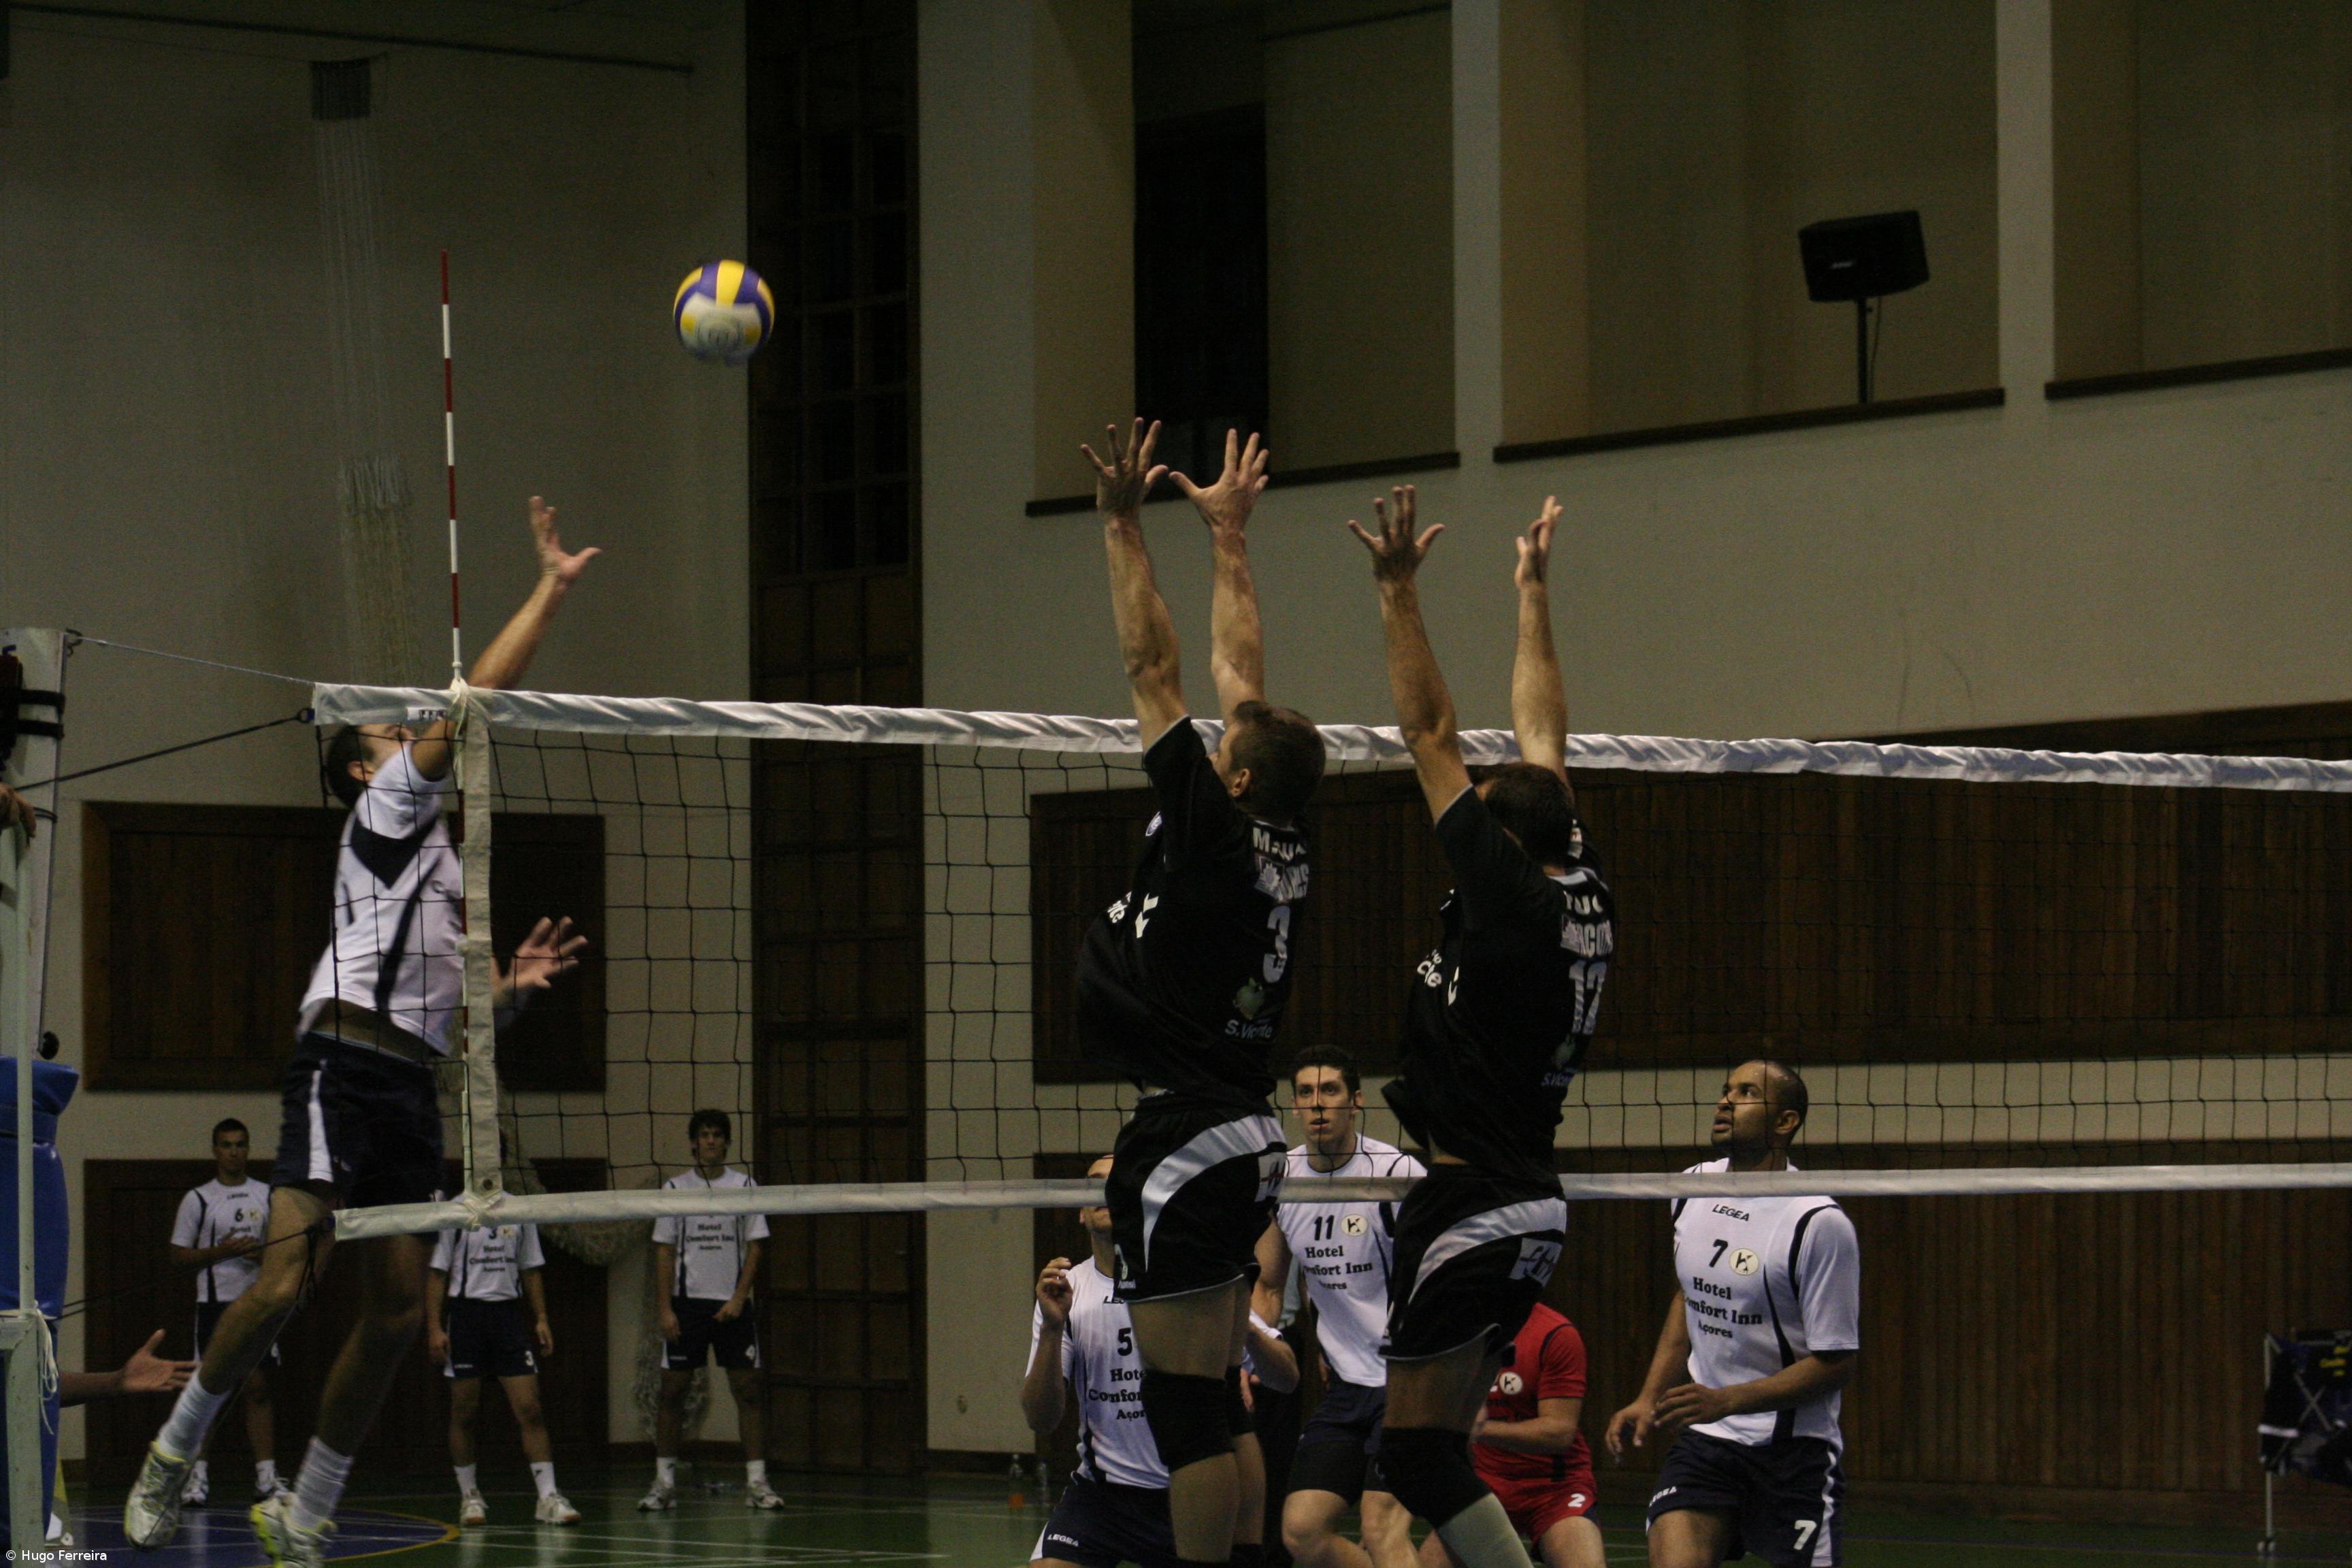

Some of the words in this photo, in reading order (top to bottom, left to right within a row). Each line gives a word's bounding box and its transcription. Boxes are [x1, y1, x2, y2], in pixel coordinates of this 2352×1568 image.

[1263, 905, 1291, 984] 3
[235, 1209, 244, 1222] 6
[1712, 1204, 1750, 1222] LEGEA
[1314, 1215, 1335, 1241] 11
[1305, 1245, 1344, 1258] Hotel
[1709, 1239, 1729, 1268] 7
[1345, 1262, 1373, 1274] Inn
[1693, 1277, 1732, 1300] Hotel
[1686, 1297, 1728, 1320] mfort
[1731, 1309, 1763, 1324] Inn
[1117, 1328, 1133, 1356] 5
[525, 1350, 534, 1367] 3
[1110, 1368, 1146, 1382] Hote
[1568, 1493, 1586, 1507] 2
[1047, 1533, 1079, 1547] LEGEA
[1793, 1520, 1817, 1550] 7
